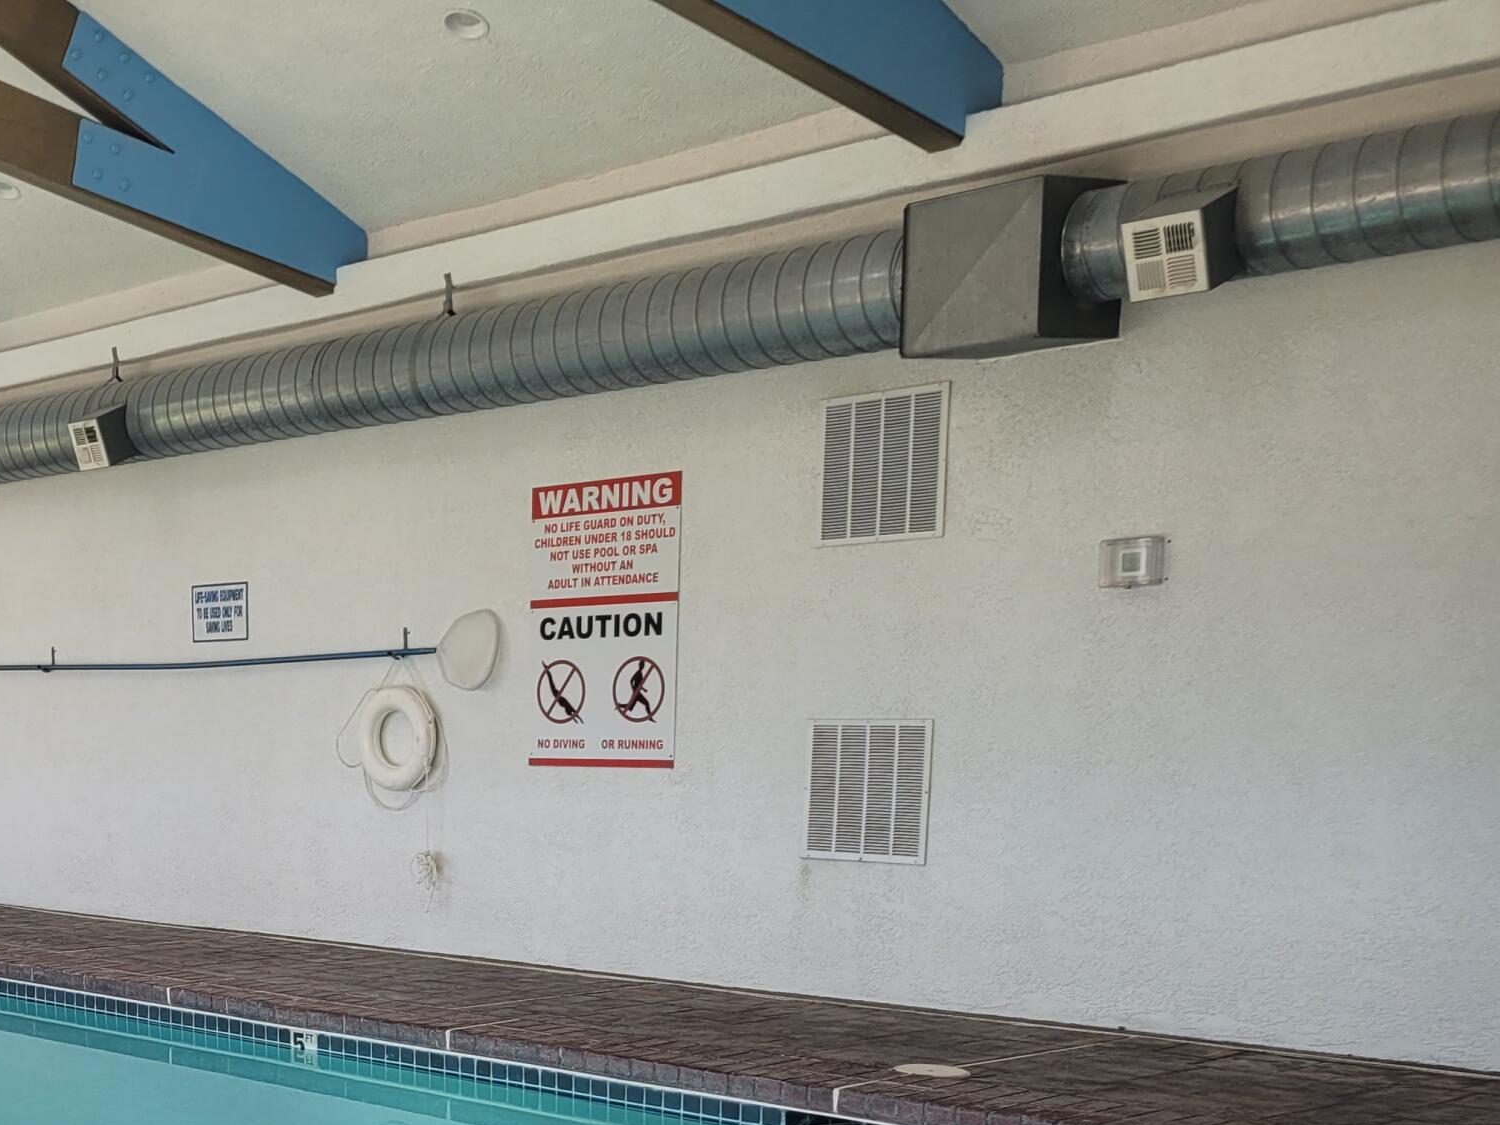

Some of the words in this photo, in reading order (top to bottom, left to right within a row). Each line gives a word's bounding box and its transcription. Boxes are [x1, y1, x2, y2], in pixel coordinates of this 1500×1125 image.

[538, 477, 673, 516] WARNING
[544, 523, 558, 534] NO
[560, 521, 580, 532] LIFE
[583, 518, 616, 530] GUARD
[619, 516, 634, 527] ON
[636, 513, 666, 526] DUTY,
[534, 535, 581, 549] CHILDREN
[584, 532, 618, 544] UNDER
[620, 530, 632, 541] 18
[634, 527, 676, 540] SHOULD
[550, 550, 569, 561] NOT
[572, 549, 591, 560] USE
[593, 546, 619, 558] POOL
[622, 545, 636, 556] OR
[639, 543, 658, 554] SPA
[572, 561, 617, 574] WITHOUT
[619, 560, 633, 571] AN
[547, 578, 578, 589] ADULT
[581, 577, 591, 587] IN
[593, 572, 659, 587] ATTENDANCE
[540, 611, 663, 641] CAUTION
[537, 739, 550, 749] NO
[553, 739, 585, 749] DIVING
[601, 739, 615, 749] OR
[618, 739, 663, 750] RUNNING
[293, 1032, 305, 1050] 5
[305, 1034, 313, 1043] FT
